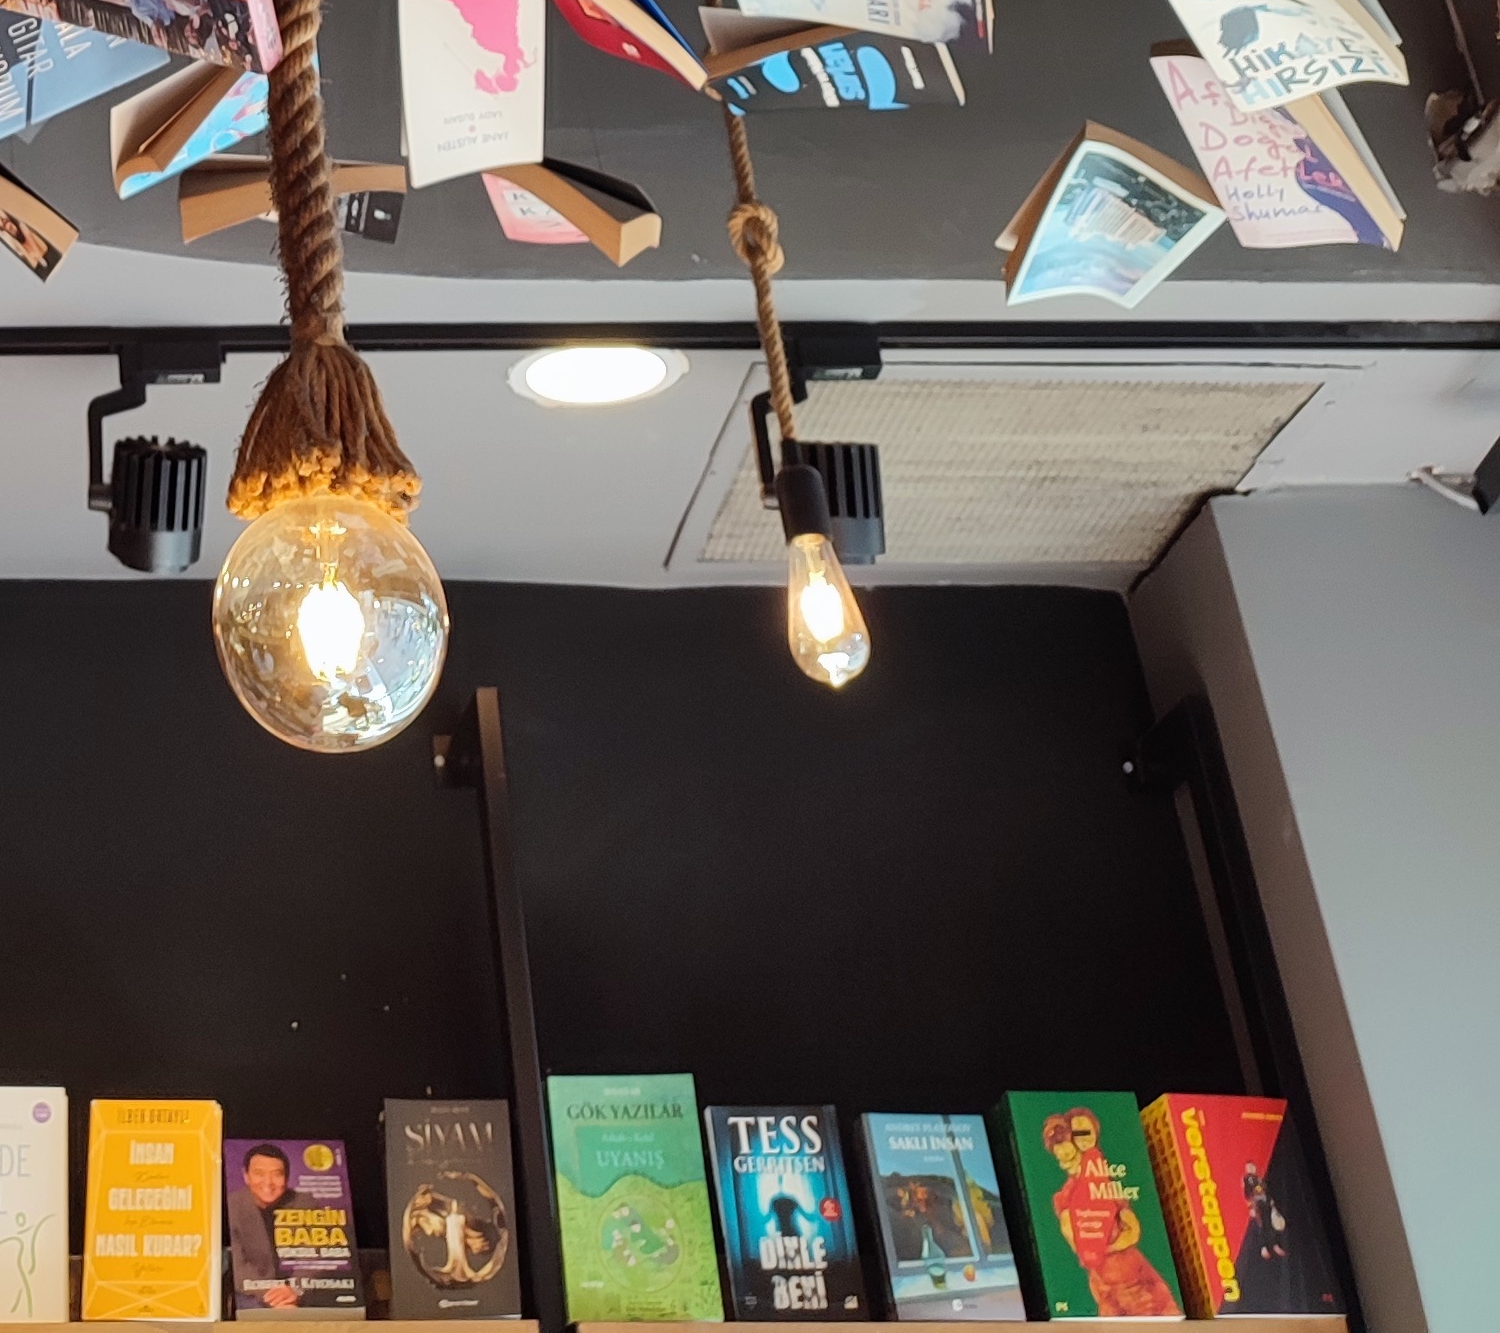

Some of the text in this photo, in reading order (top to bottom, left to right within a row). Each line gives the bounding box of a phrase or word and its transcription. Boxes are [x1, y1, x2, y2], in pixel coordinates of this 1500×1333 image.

[1225, 183, 1285, 213] Holly
[566, 1102, 685, 1121] GÖK YAZILAR
[728, 1114, 823, 1156] TESS
[888, 1135, 975, 1152] SAKLI İNSAN
[129, 1139, 175, 1166] İNSAN
[596, 1149, 665, 1170] UYANIŞ
[1084, 1158, 1127, 1180] Alice
[108, 1184, 193, 1212] GELECEĞİNİ
[1089, 1180, 1141, 1203] Miller
[1180, 1106, 1241, 1304] Verstappen
[274, 1208, 348, 1226] ZENGİN
[95, 1233, 203, 1259] NASIL KURAR?
[274, 1227, 349, 1247] BABA
